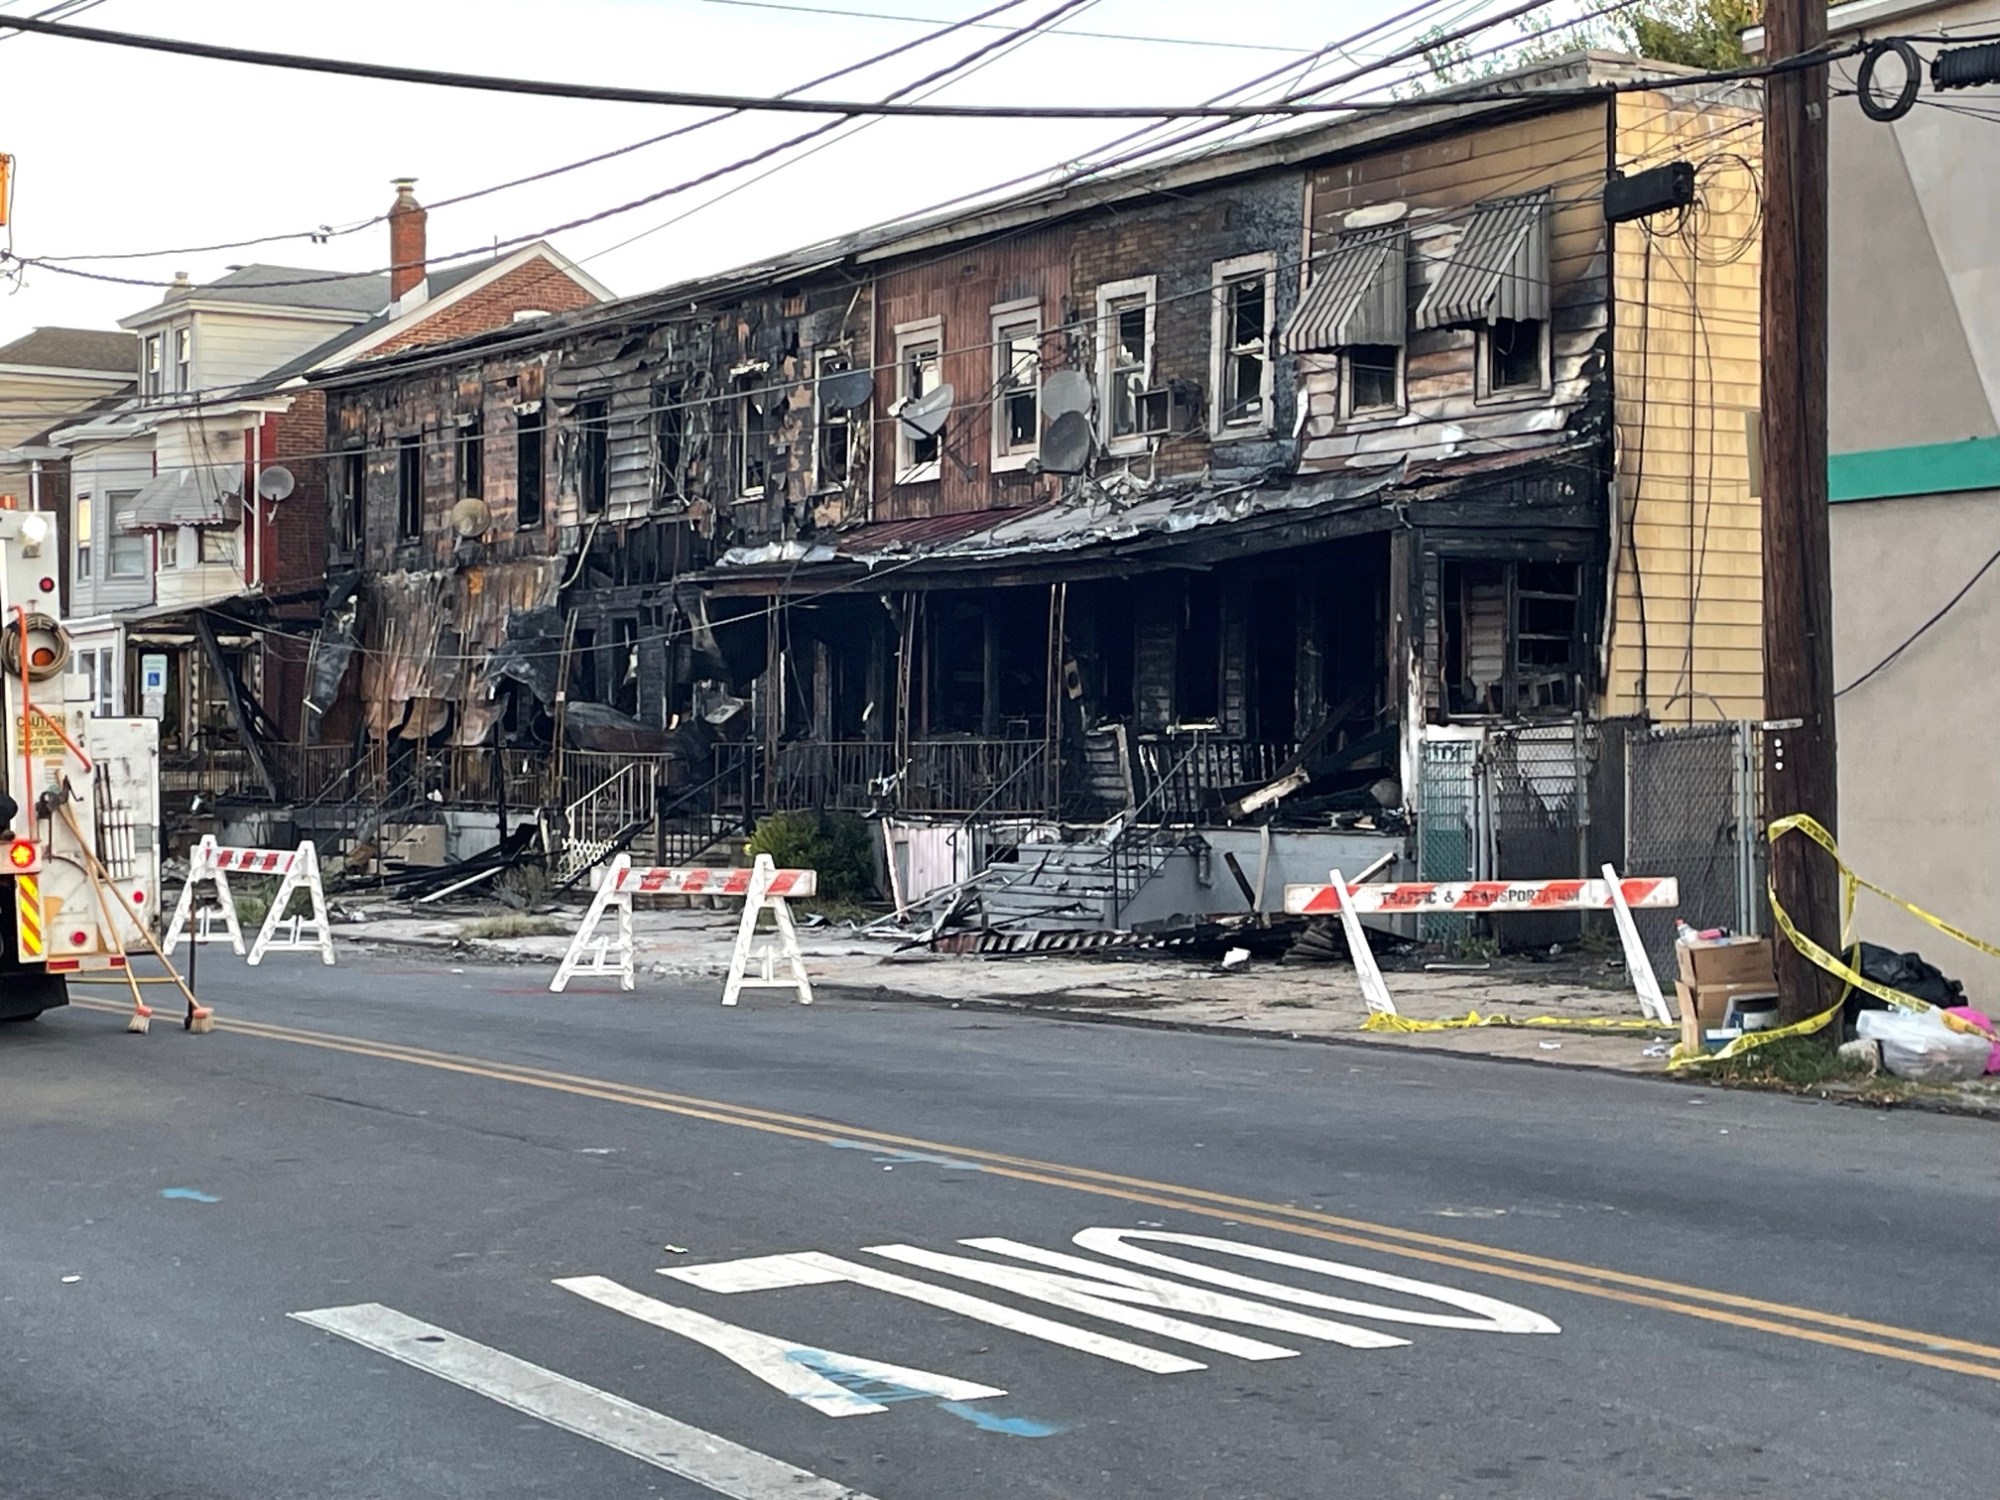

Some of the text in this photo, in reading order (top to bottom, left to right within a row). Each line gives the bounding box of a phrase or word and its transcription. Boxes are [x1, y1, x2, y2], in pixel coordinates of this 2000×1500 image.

[17, 716, 66, 728] CUTION
[1380, 888, 1580, 905] TRAFFIC & TRANSPORTATION
[551, 1226, 1561, 1417] ONLY
